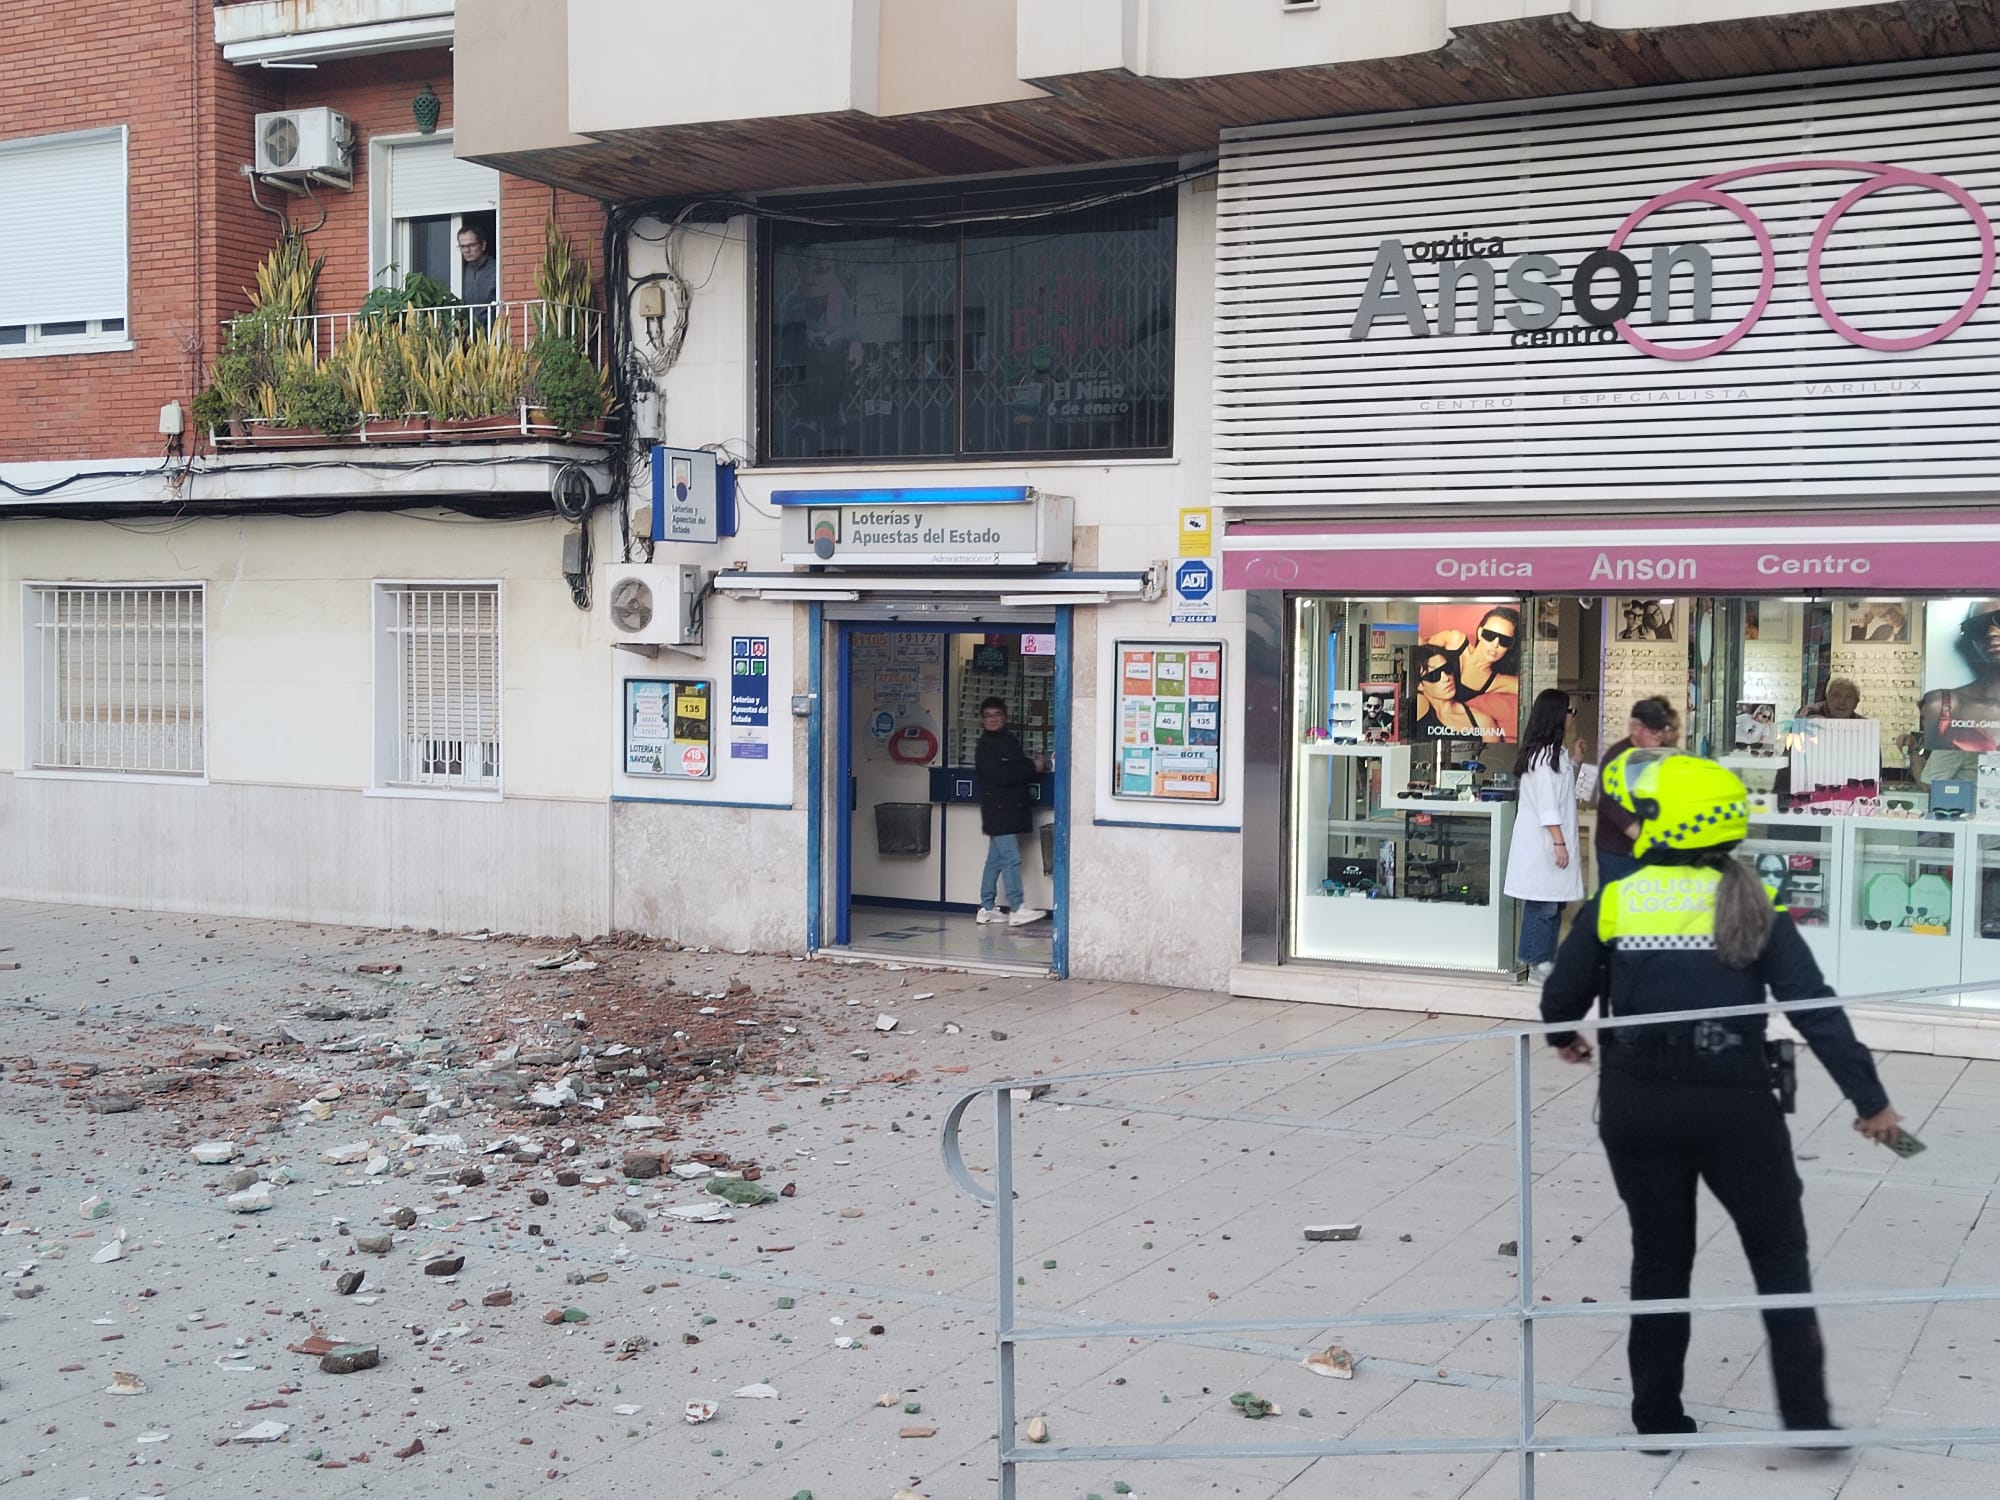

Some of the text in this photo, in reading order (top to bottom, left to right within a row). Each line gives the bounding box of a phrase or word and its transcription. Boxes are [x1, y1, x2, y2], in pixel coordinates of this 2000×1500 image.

[1411, 232, 1504, 263] optica
[1349, 239, 1713, 339] Anson
[1510, 325, 1618, 348] centro
[1053, 379, 1125, 400] El Niño
[1419, 381, 1923, 411] CENTRO ESPECIALISTA VARILUX
[1047, 401, 1129, 416] 6 de enero
[851, 510, 922, 528] Loterías y
[852, 528, 1000, 547] Apuestas del Estado
[1435, 553, 1871, 580] Optica Anson Centro
[1181, 572, 1208, 588] ADT
[683, 704, 700, 714] 135
[1427, 725, 1456, 736] DOLCE
[1461, 726, 1506, 737] GABBANA
[629, 743, 663, 754] LOTERÍA DE
[1180, 751, 1205, 759] BOTE
[1181, 774, 1206, 782] BOTE
[1629, 897, 1710, 913] LOCAL
